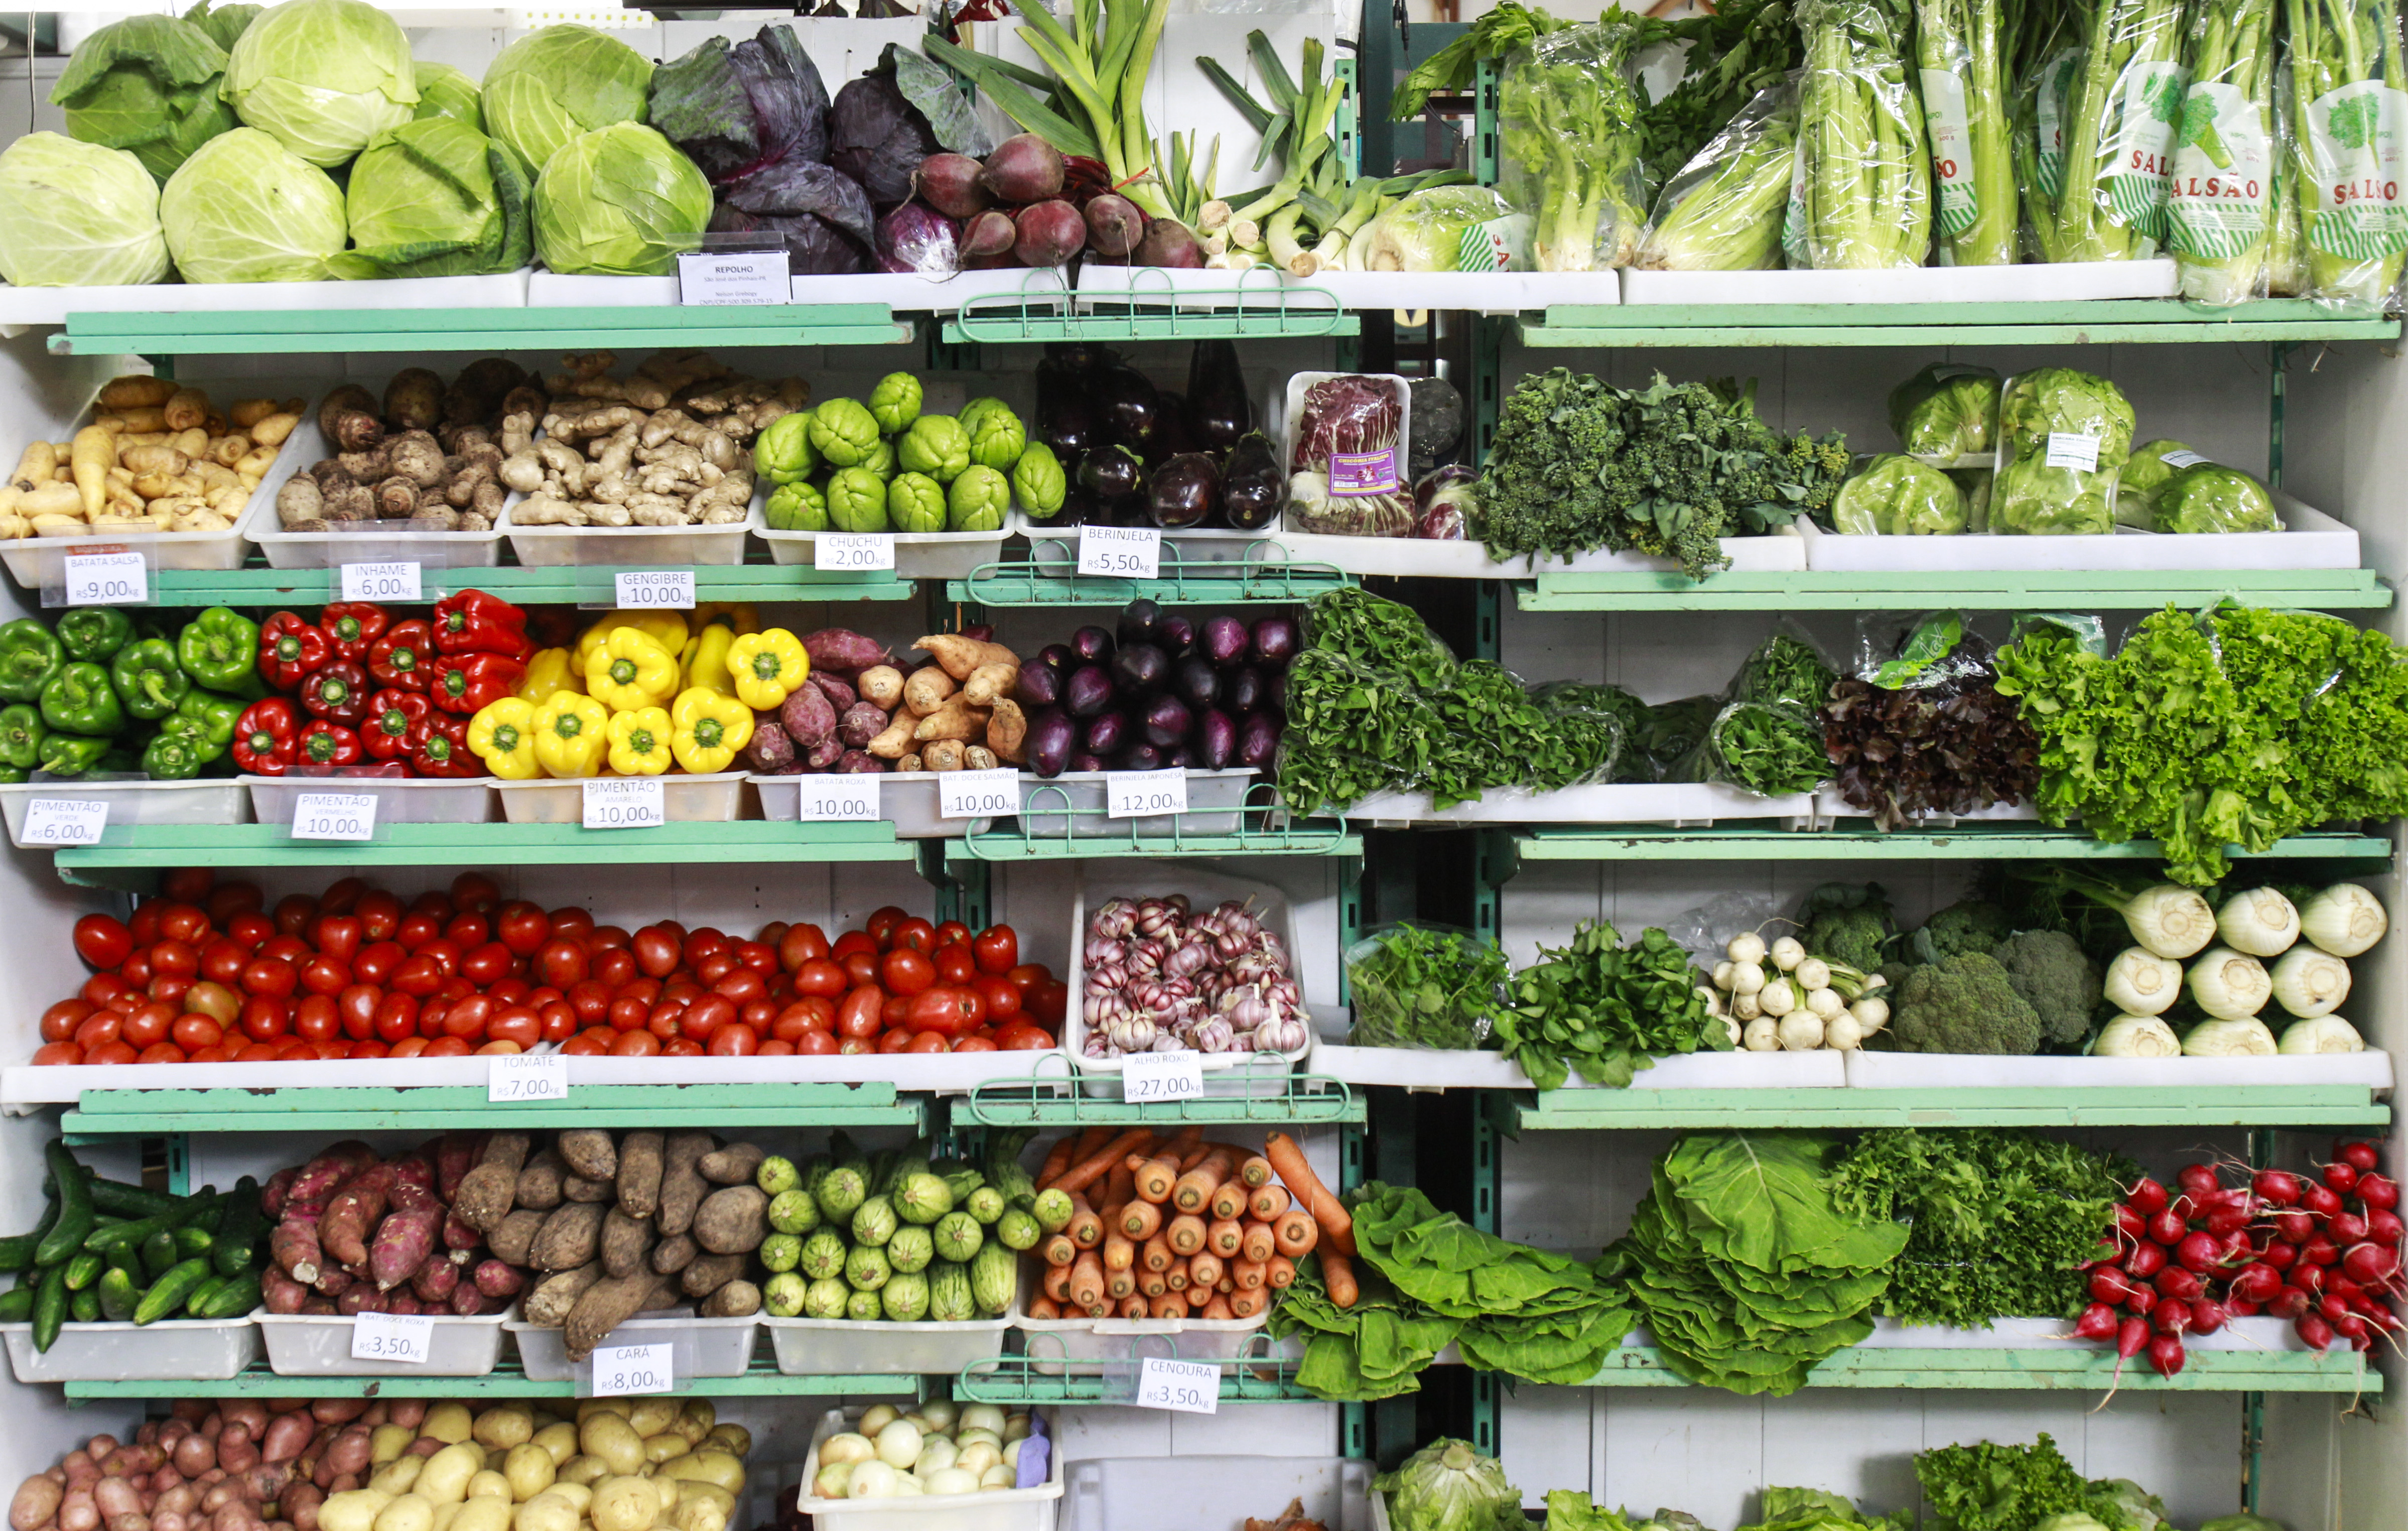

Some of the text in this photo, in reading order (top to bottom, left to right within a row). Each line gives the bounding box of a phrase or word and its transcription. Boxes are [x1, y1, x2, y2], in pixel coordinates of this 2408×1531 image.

[2131, 150, 2175, 177] SAL
[2171, 172, 2259, 199] ALSÃO
[1089, 528, 1153, 542] BERINJELA
[829, 537, 882, 547] CHUCHU
[71, 556, 140, 567] BATATA SALSA
[355, 564, 408, 576] INHAME
[623, 574, 687, 584] GENGIBRE
[984, 772, 1015, 781] SALMÃO
[588, 780, 656, 793] PIMENTÃO
[503, 1055, 555, 1068] TOMATE
[1134, 1054, 1189, 1065] ALHO ROXO
[383, 1316, 403, 1324] DOCE
[616, 1345, 650, 1360] CARÁ
[1151, 1360, 1212, 1379] CENOURA
